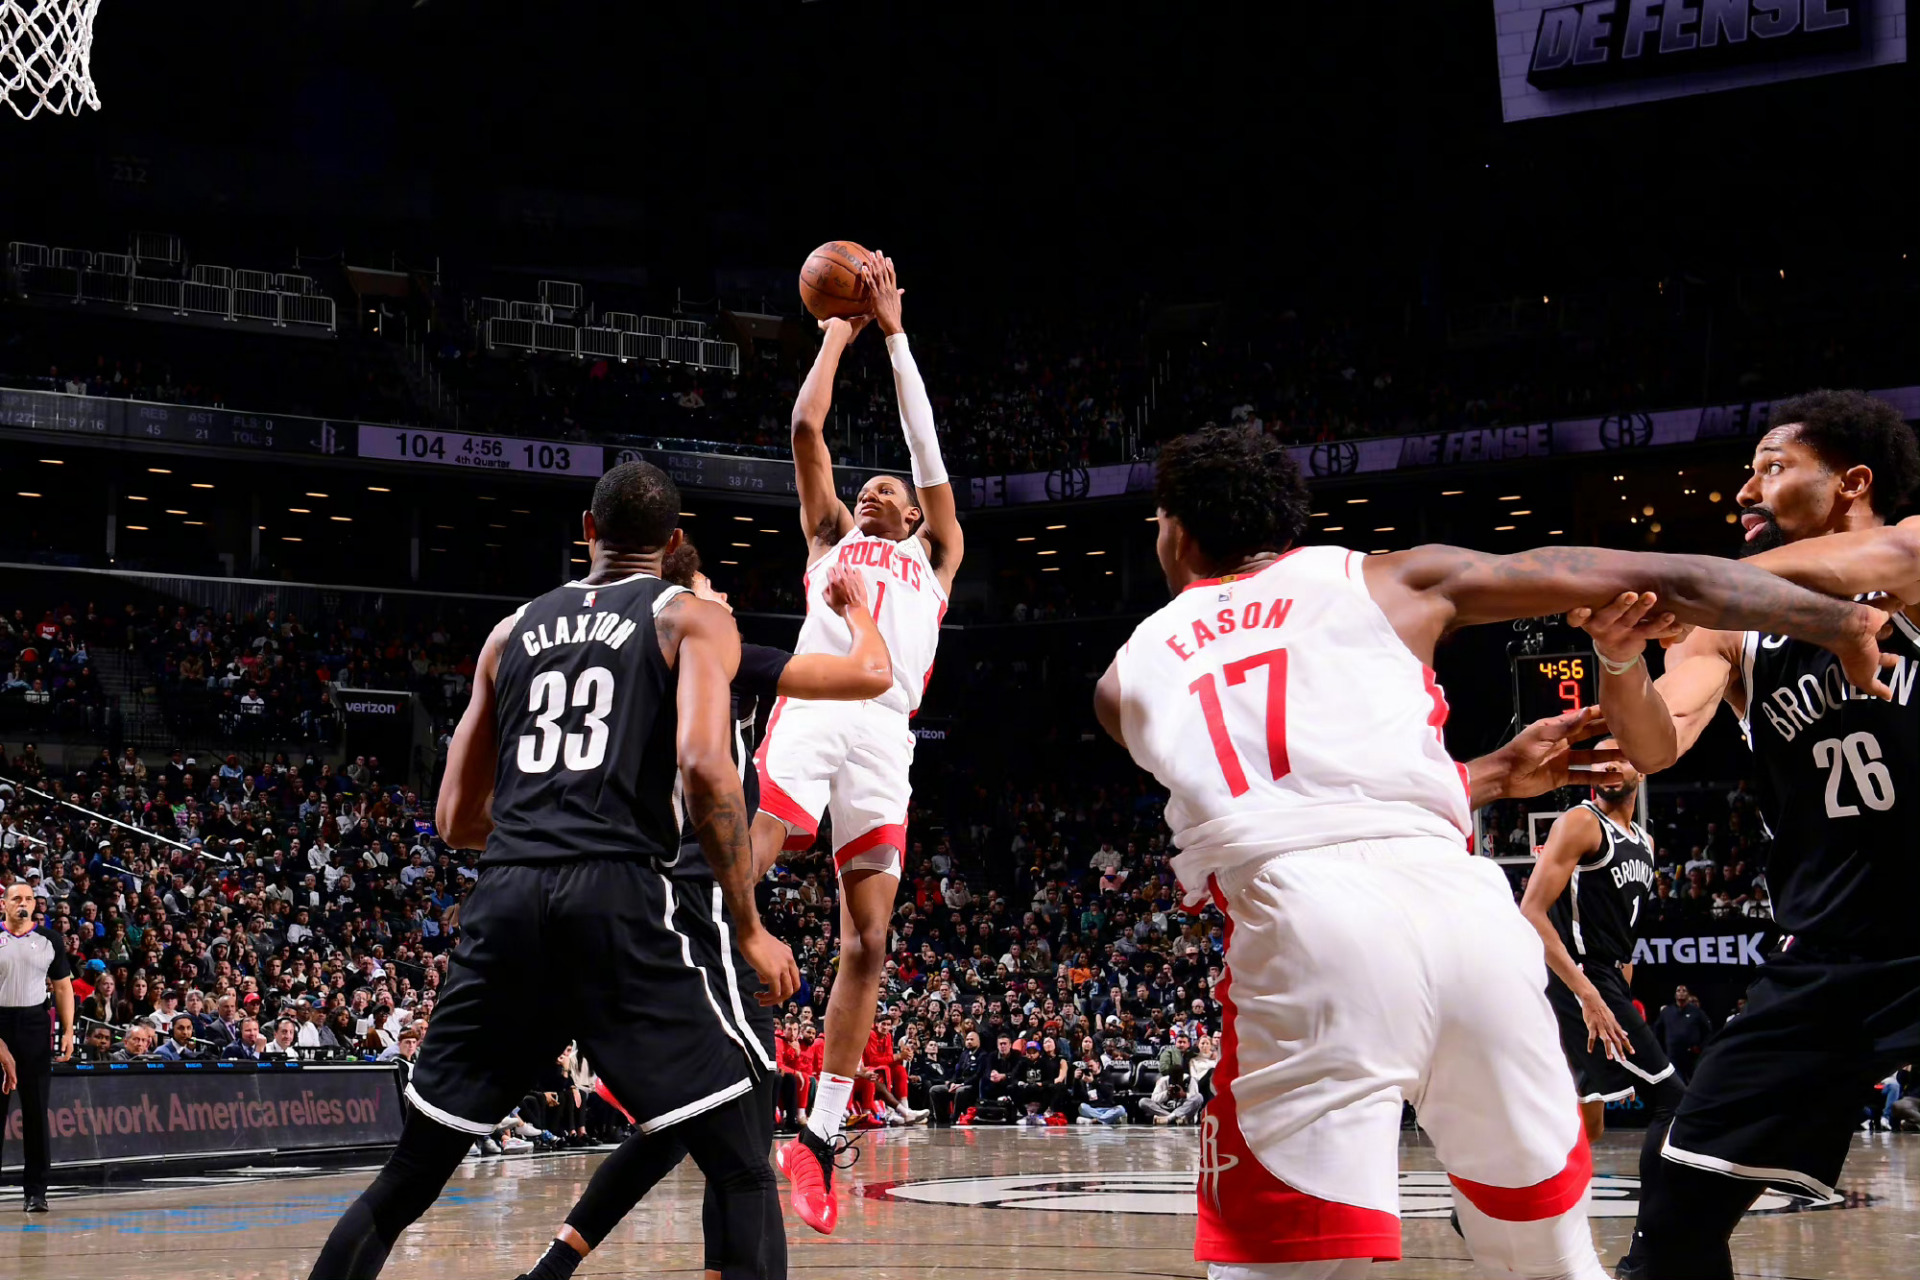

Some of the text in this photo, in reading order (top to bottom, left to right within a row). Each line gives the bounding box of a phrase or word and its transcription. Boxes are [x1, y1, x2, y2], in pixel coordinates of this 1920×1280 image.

[140, 407, 168, 420] REB
[146, 424, 161, 436] 45
[187, 412, 214, 425] AST
[195, 428, 209, 440] 21
[265, 435, 273, 447] 3
[397, 433, 571, 470] 104 4:56 103
[454, 455, 510, 469] 4th Quarter
[838, 541, 922, 592] ROCKETS
[873, 581, 886, 625] 1
[522, 611, 637, 657] CLAXTON
[1165, 598, 1294, 661] EASON
[1539, 659, 1584, 680] 4:56
[345, 700, 396, 714] verizon
[1558, 680, 1580, 715] 9
[1762, 655, 1919, 742] BROOLN
[517, 667, 615, 773] 33
[910, 727, 946, 740] rizon
[1188, 648, 1291, 798] 17
[1812, 731, 1896, 818] 26
[1610, 859, 1654, 892] BROOKLY
[1630, 895, 1640, 928] 1
[1632, 932, 1766, 966] ATGEEK
[47, 1093, 165, 1138] network
[168, 1091, 279, 1132] America
[279, 1090, 345, 1126] relies
[345, 1097, 376, 1123] on
